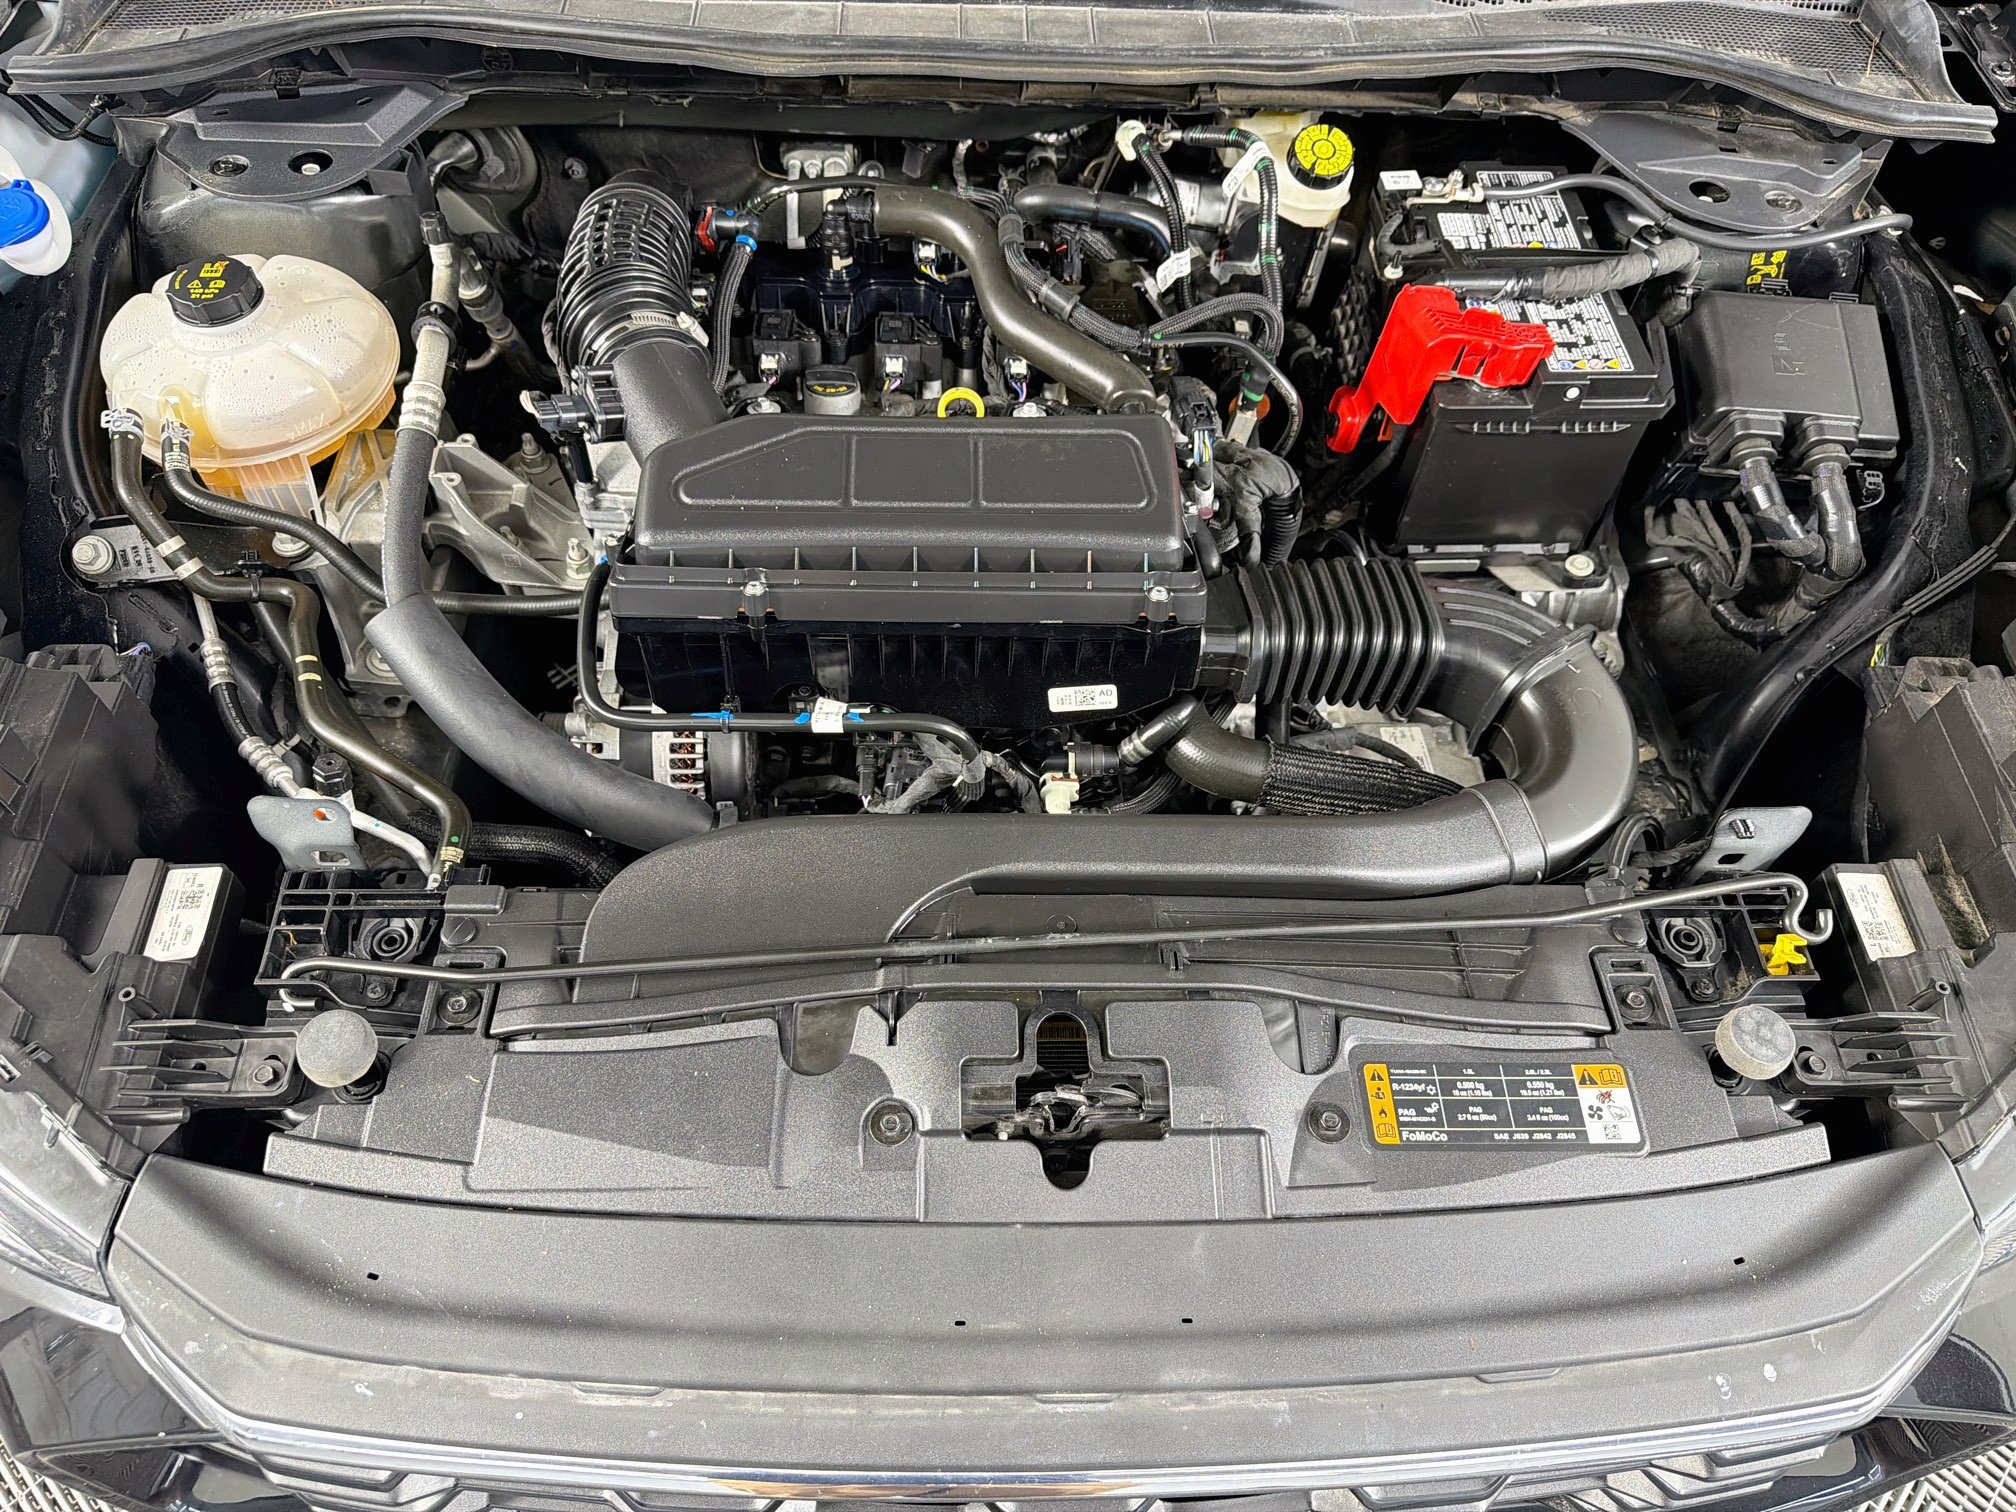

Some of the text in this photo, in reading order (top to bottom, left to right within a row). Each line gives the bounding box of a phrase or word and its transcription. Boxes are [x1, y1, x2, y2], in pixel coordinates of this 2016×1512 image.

[1392, 1083, 1426, 1092] R-1234yf
[1475, 1082, 1485, 1090] kg
[1545, 1081, 1554, 1090] kg
[1402, 1131, 1448, 1141] FoMoCo
